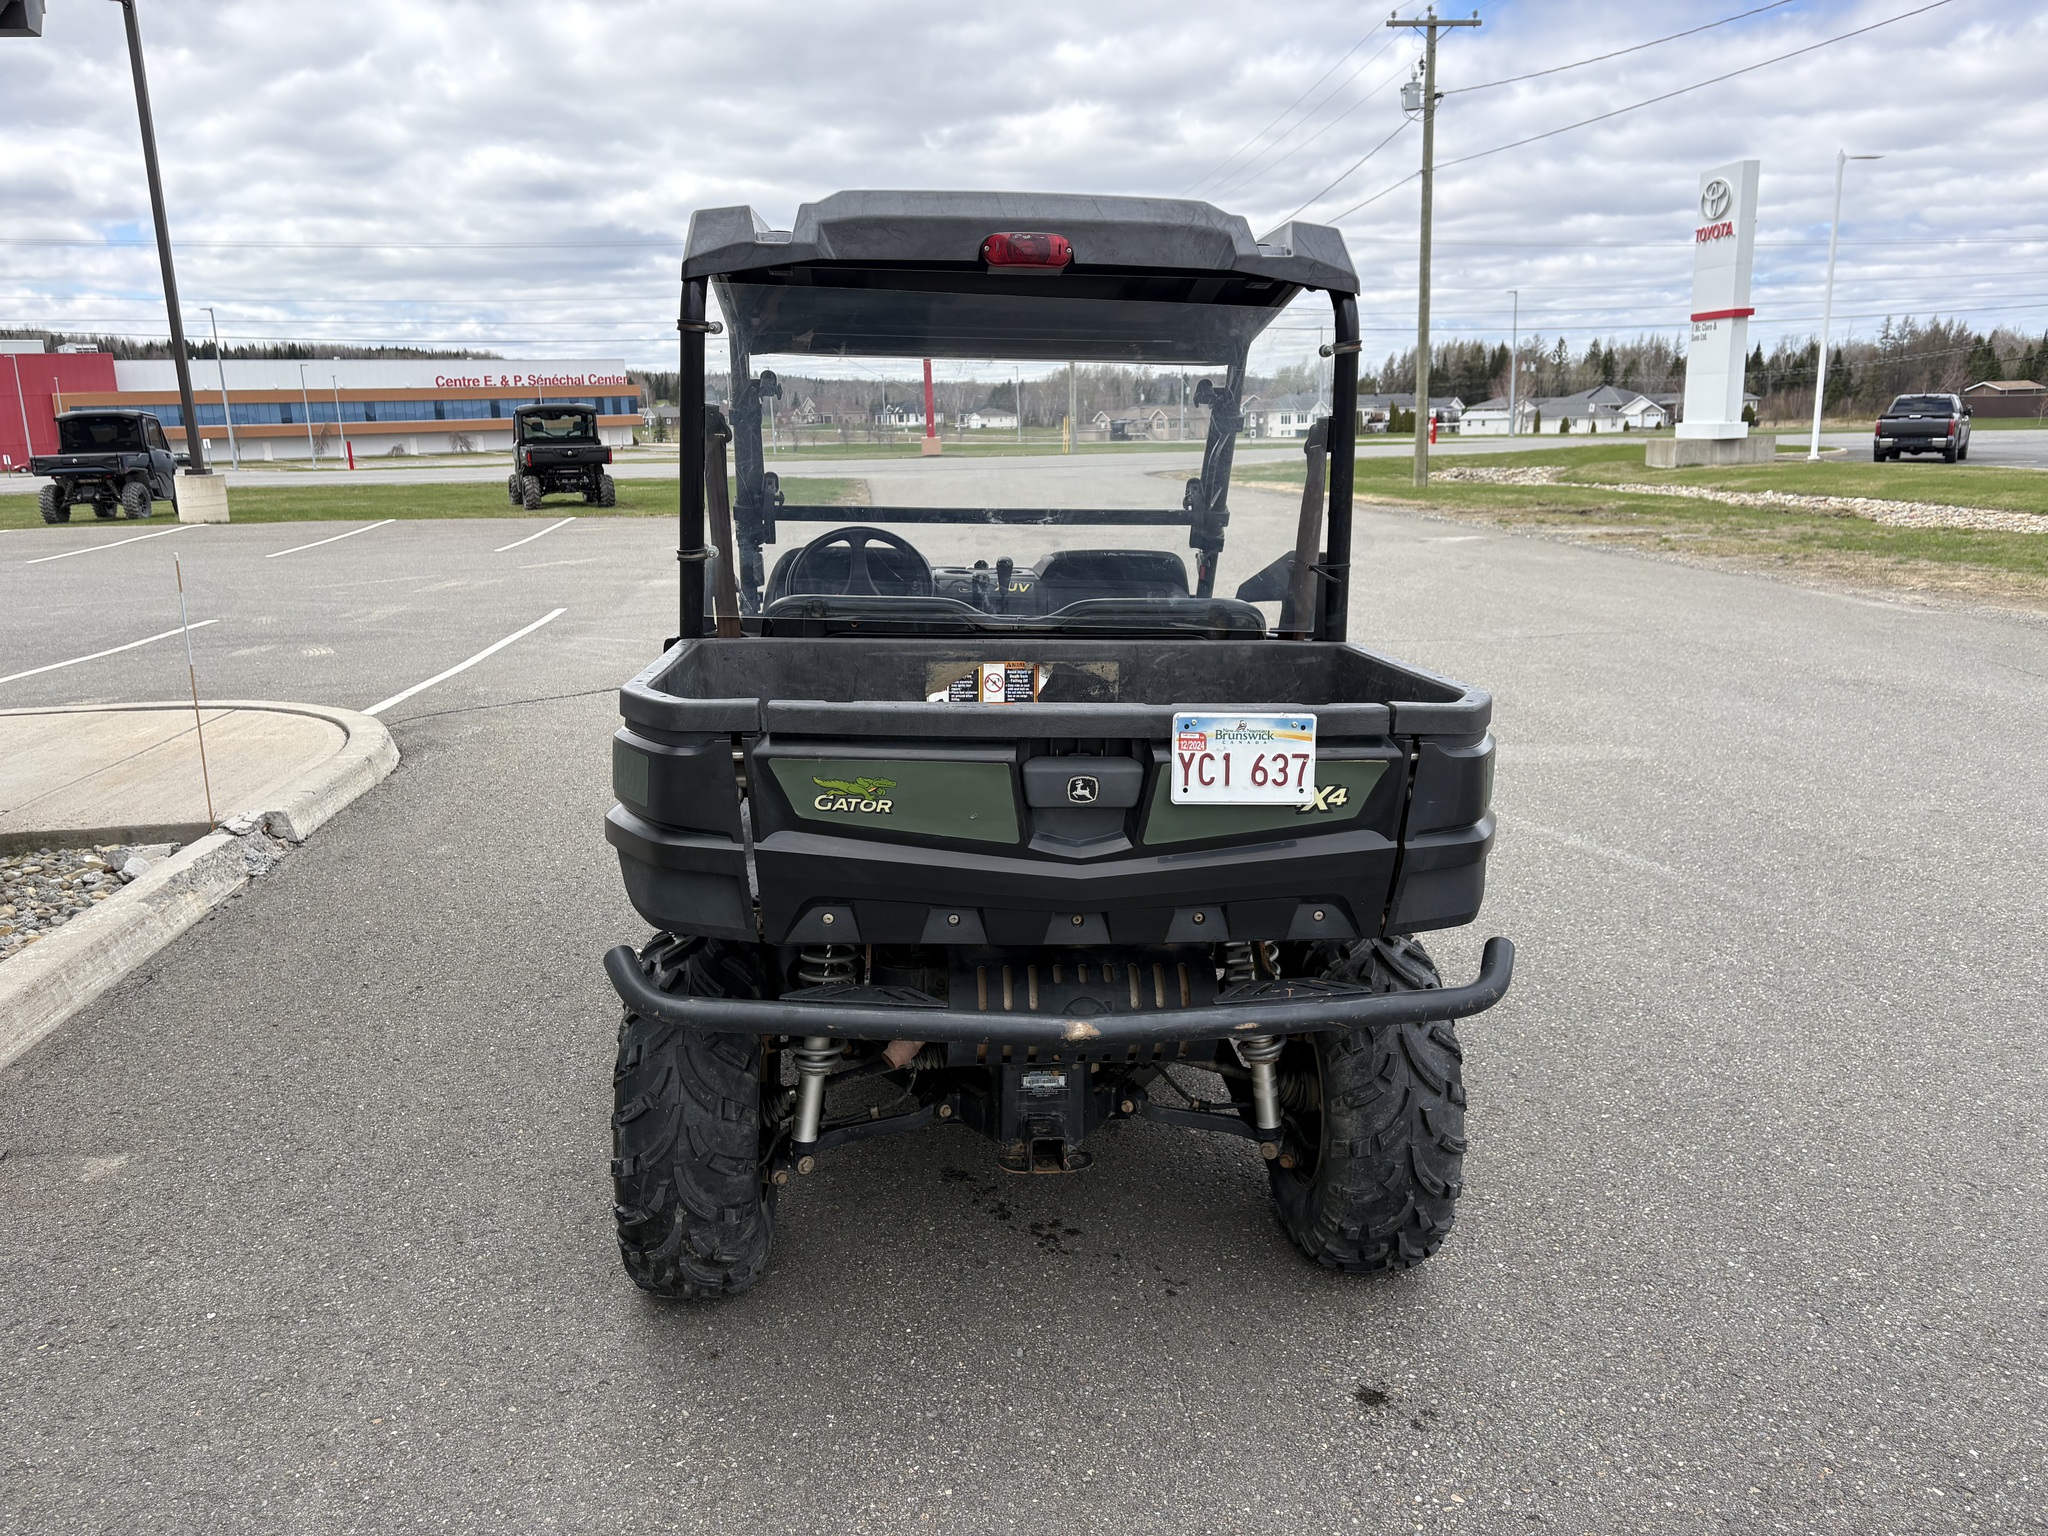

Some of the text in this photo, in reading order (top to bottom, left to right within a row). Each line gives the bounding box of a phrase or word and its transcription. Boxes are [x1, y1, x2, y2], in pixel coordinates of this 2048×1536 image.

[1695, 221, 1734, 243] TOYOTA
[435, 373, 628, 387] Centre E. & P. Sénéchal Center
[1215, 730, 1274, 740] Brunswick
[1180, 740, 1205, 750] 12/2024
[1178, 752, 1310, 787] YC1 637
[814, 794, 893, 813] GATOR
[1296, 785, 1348, 812] X4
